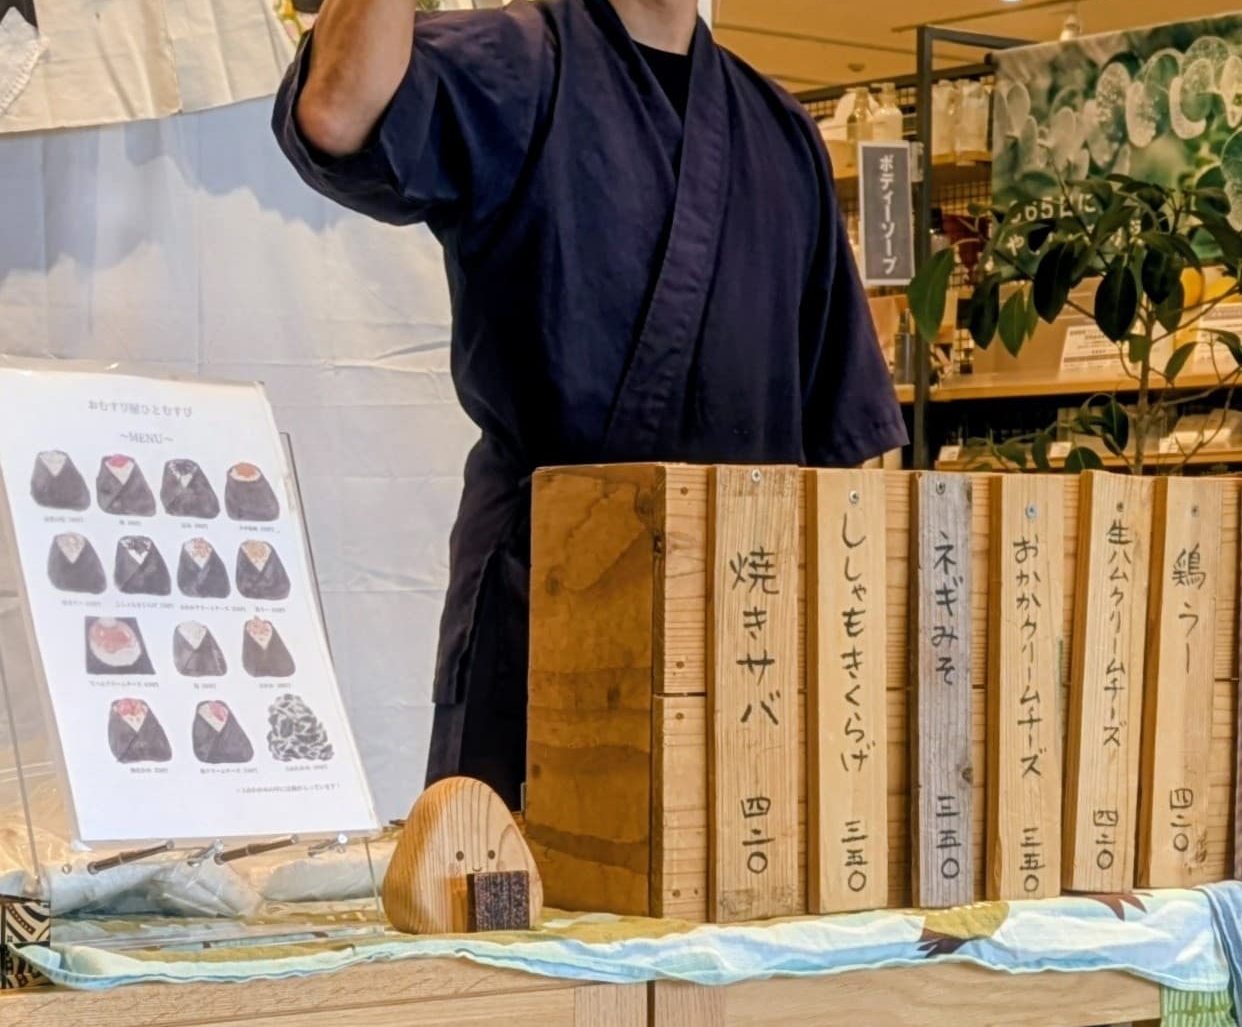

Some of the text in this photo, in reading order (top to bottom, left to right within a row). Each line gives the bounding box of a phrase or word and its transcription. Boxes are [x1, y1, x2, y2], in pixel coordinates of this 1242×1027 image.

[879, 154, 897, 275] ボディーソープ
[729, 546, 780, 725] 焼きサバ
[840, 513, 875, 772] ししゃもきくらげ
[931, 531, 962, 685] ネギみそ
[1013, 536, 1046, 778] おかかクリームチーズ
[1103, 519, 1132, 747] 生ハムクリームチーズ
